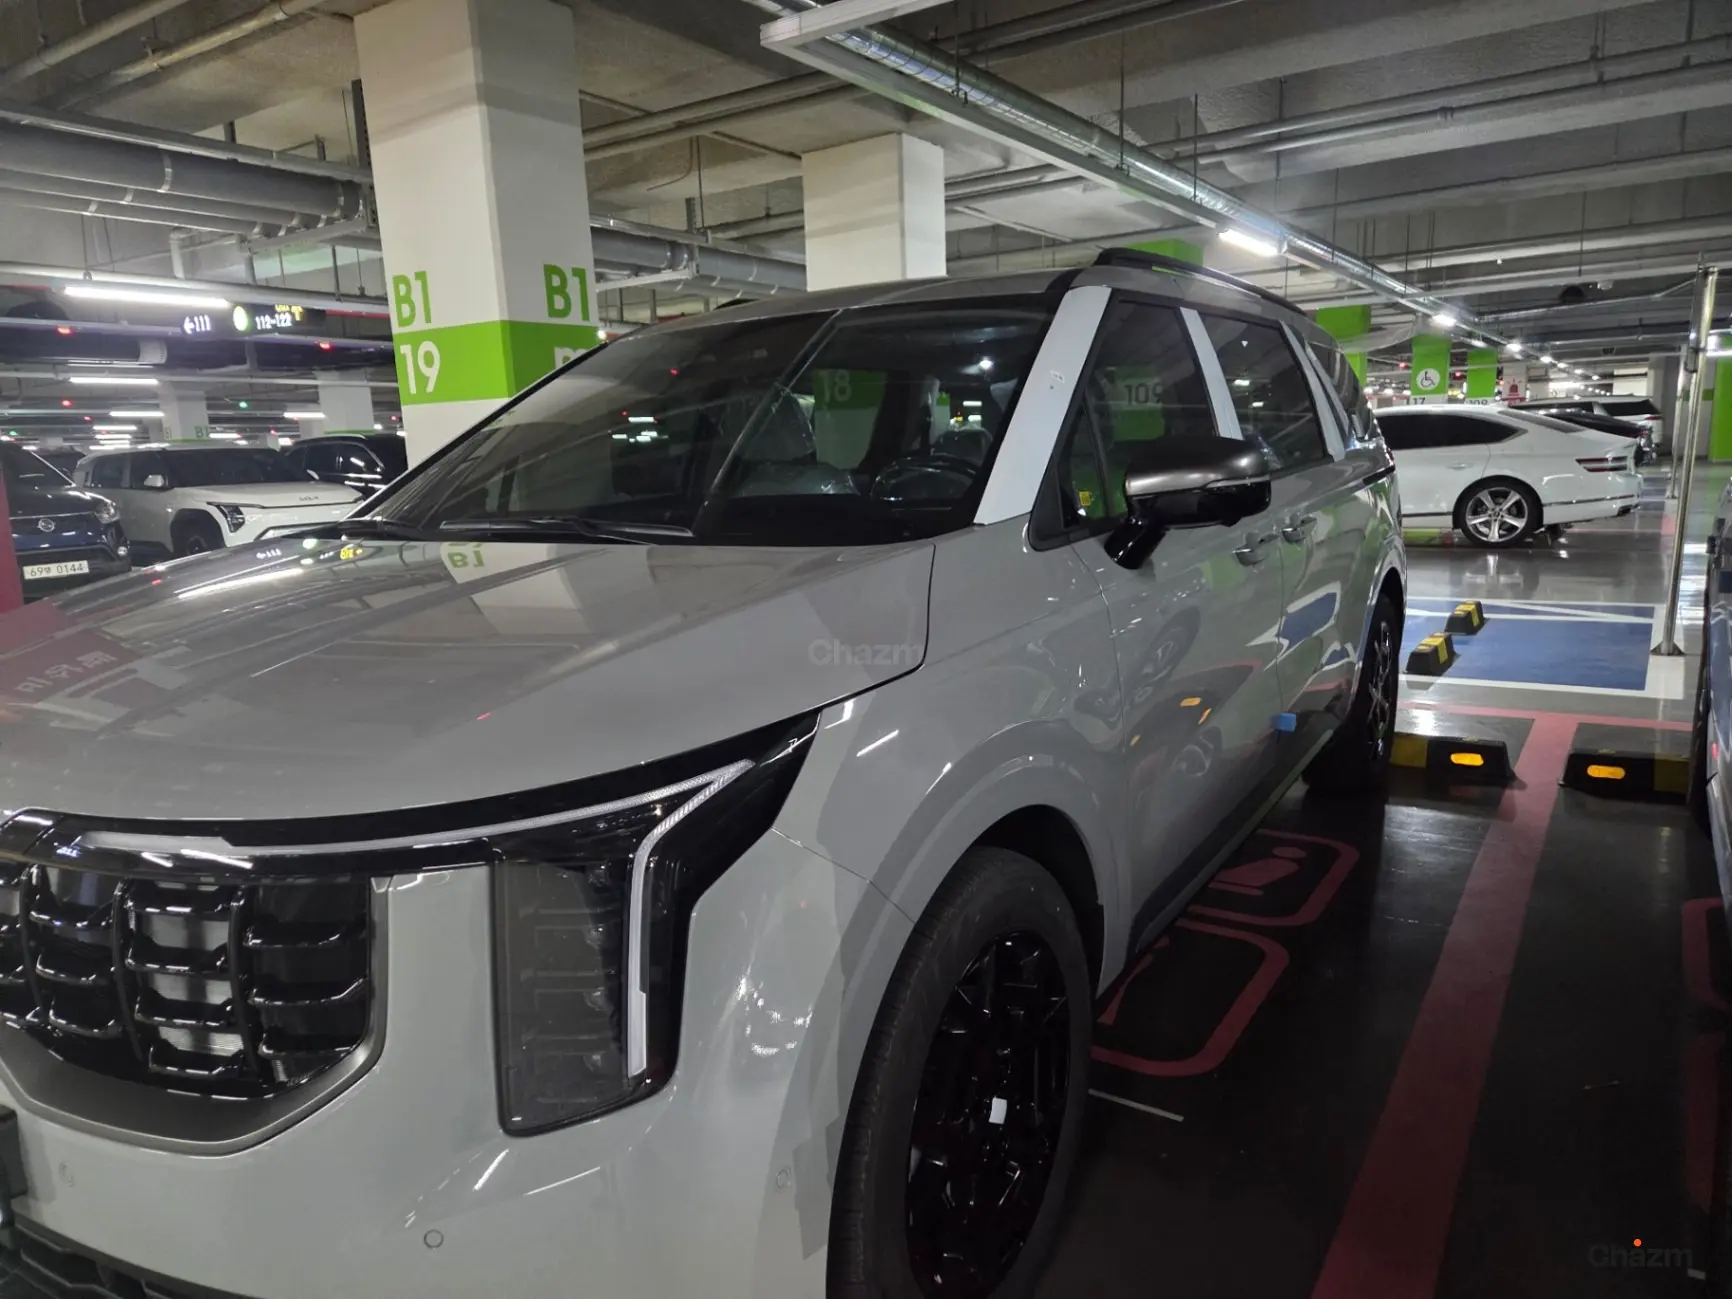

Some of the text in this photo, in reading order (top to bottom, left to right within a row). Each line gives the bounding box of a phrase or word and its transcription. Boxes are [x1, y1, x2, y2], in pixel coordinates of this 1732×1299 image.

[392, 270, 432, 328] B1
[543, 263, 590, 322] B1
[194, 314, 212, 332] 111
[400, 340, 441, 395] 19
[818, 369, 852, 403] 18
[56, 563, 83, 574] 0144
